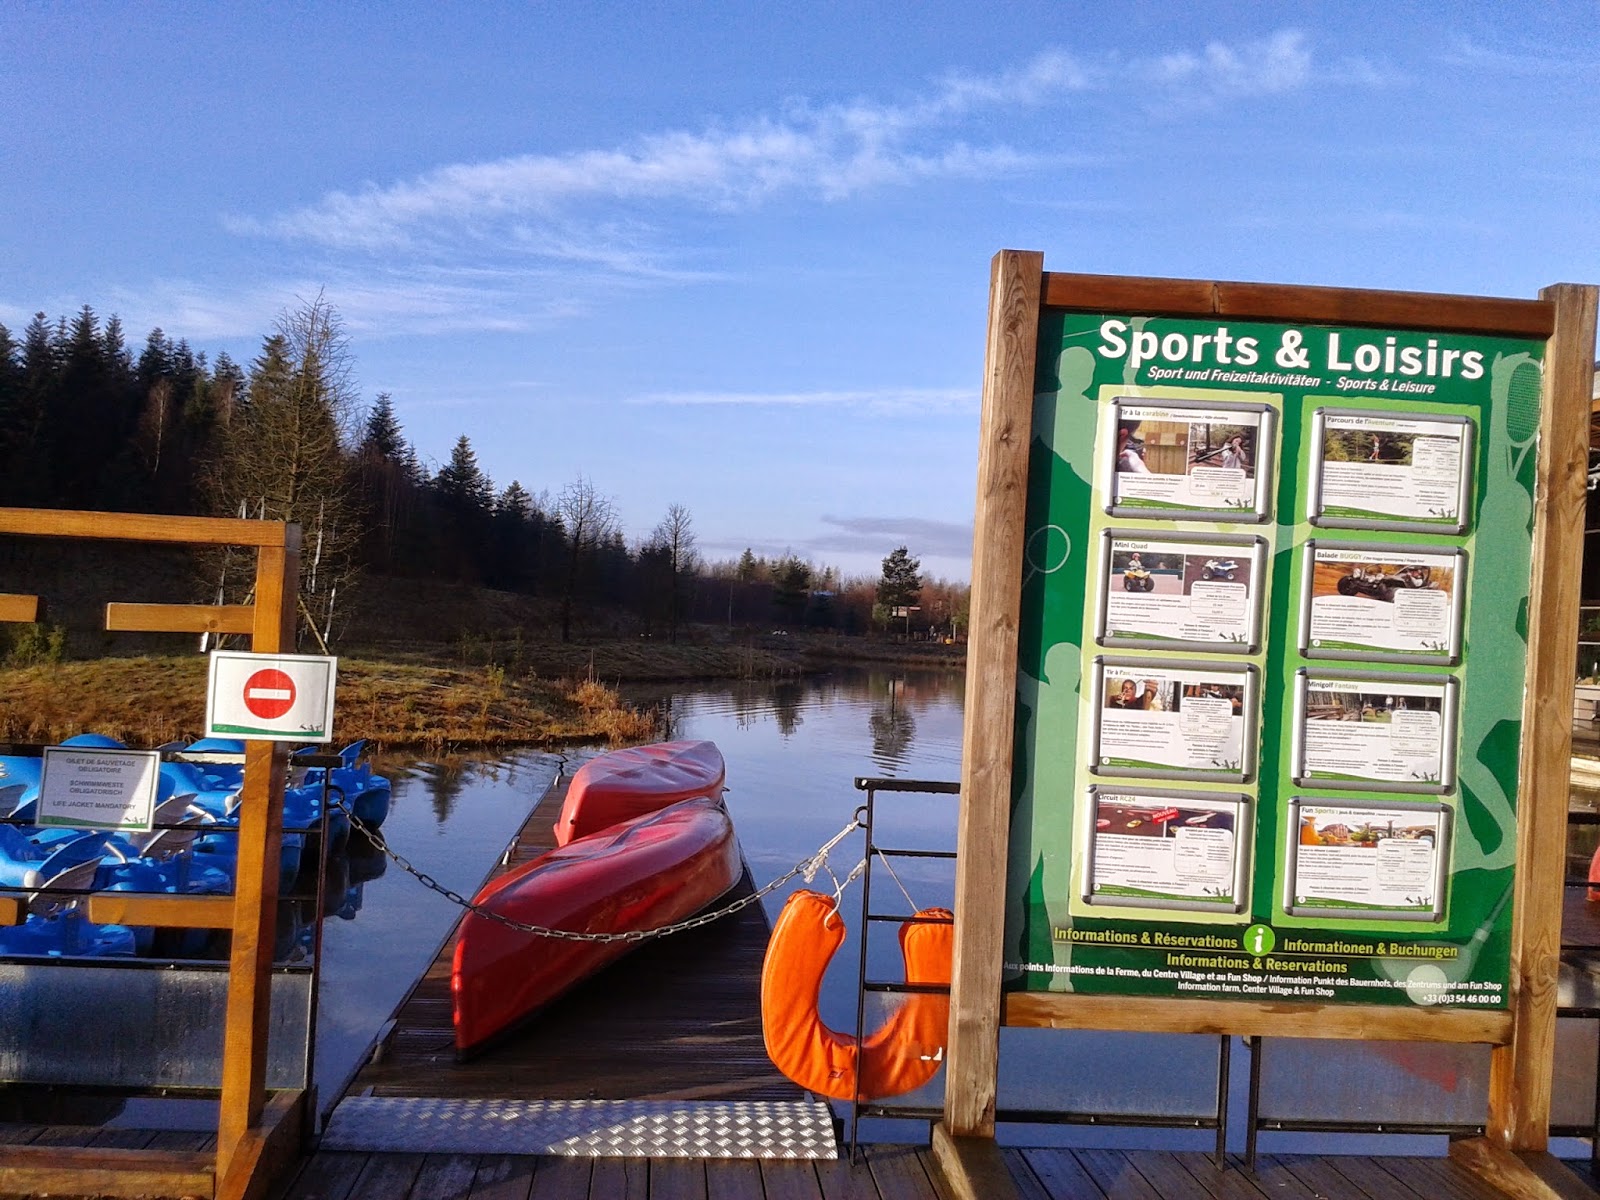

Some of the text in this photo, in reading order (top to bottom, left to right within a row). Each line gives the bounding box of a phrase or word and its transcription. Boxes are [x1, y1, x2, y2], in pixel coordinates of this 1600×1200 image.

[1098, 319, 1484, 379] Sports & Loisirs
[1147, 366, 1183, 380] Sport
[1185, 368, 1208, 380] und
[1211, 369, 1321, 387] Freizeitaktivitäten
[1336, 376, 1377, 391] Sports
[1379, 381, 1390, 391] &
[1391, 380, 1436, 394] Leisure
[1334, 682, 1359, 690] Fantasy
[78, 766, 122, 774] OBLIGATOIRE
[97, 759, 136, 767] SAUVETAGE
[1054, 927, 1137, 943] Informations
[1141, 931, 1151, 944] &
[1154, 932, 1238, 948] Réservations
[1284, 938, 1373, 954] Informationen
[1376, 942, 1386, 955] &
[1390, 943, 1458, 958] Buchungen
[1167, 953, 1347, 973] Informations & Reservations
[1019, 963, 1043, 972] points
[1045, 964, 1094, 975] Informations
[1096, 966, 1105, 975] de
[1107, 967, 1114, 975] la
[1142, 968, 1151, 977] du
[1153, 969, 1179, 979] Centre
[1180, 971, 1205, 981] Village
[1206, 972, 1215, 980] et
[1228, 973, 1241, 982] Fun
[1242, 973, 1262, 984] Shop
[1269, 975, 1312, 985] Information
[1313, 976, 1335, 985] Punkt
[1335, 978, 1349, 986] des
[1394, 980, 1406, 988] des
[1408, 980, 1441, 989] Zentrums
[1443, 981, 1456, 989] und
[1470, 981, 1483, 990] Fun
[1484, 982, 1502, 991] Shop
[1178, 982, 1221, 991] Information
[1242, 985, 1267, 994] Center
[1269, 986, 1293, 996] Village
[1294, 987, 1300, 995] &
[1301, 987, 1314, 995] Fun
[1316, 987, 1335, 997] Shop
[1423, 994, 1501, 1004] +33 (0)3 54 46 00 00
